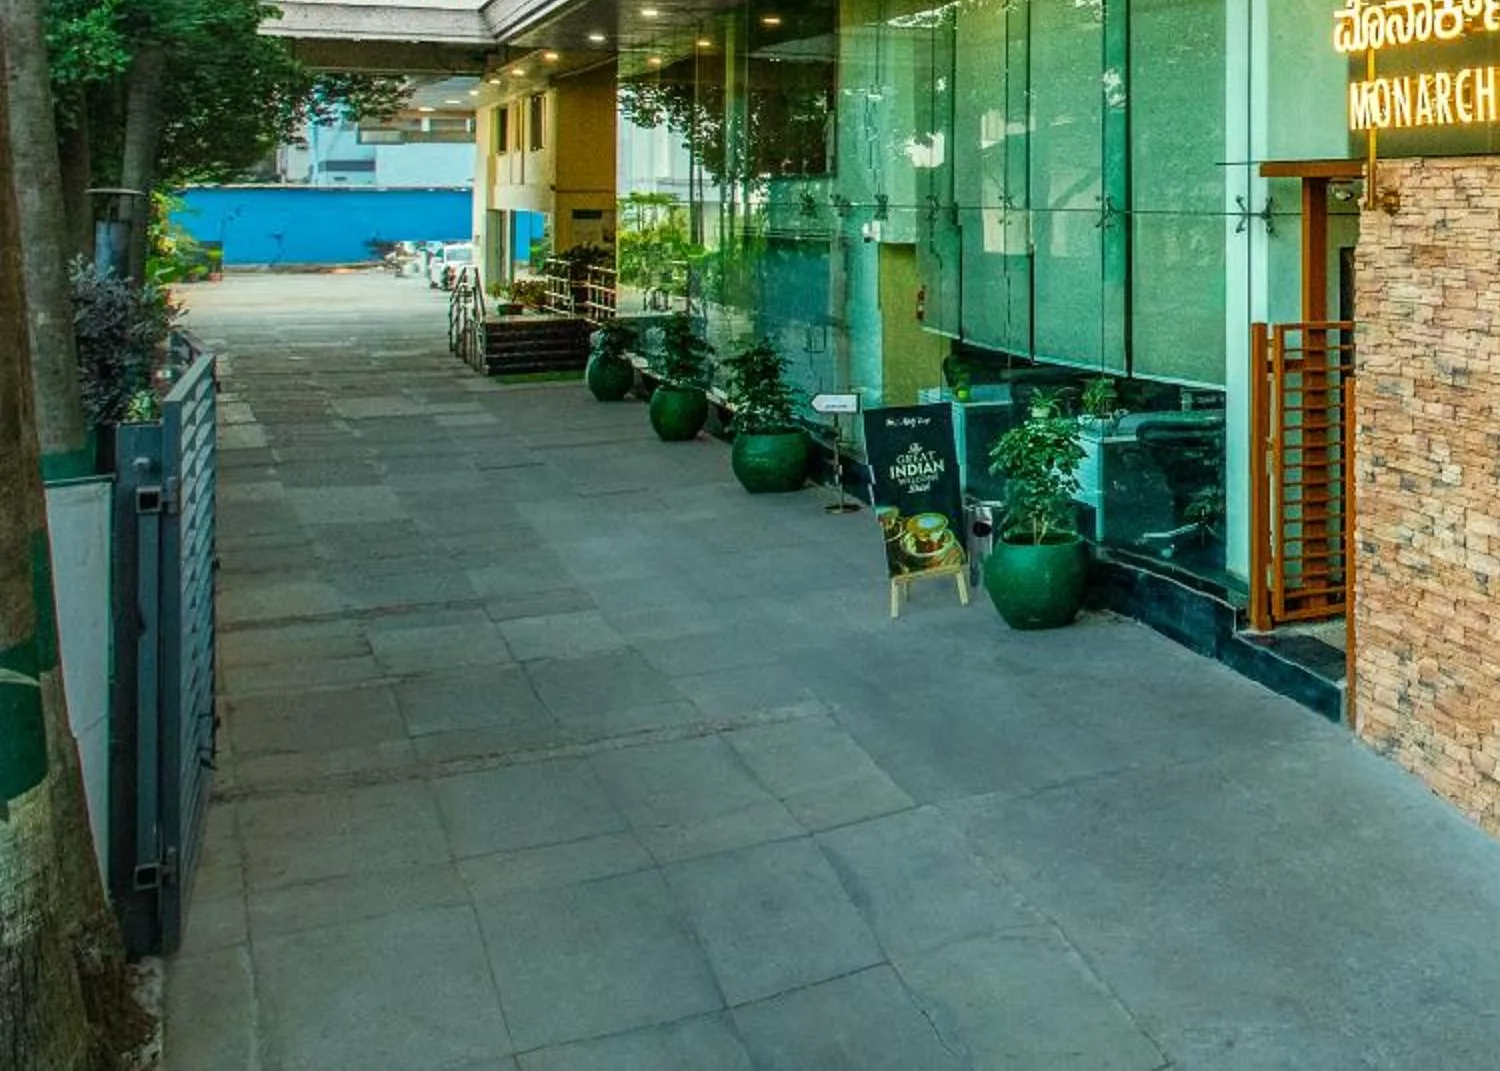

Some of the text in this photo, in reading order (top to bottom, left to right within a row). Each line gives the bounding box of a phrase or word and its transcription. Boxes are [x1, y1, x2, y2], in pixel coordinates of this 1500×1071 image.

[1349, 66, 1497, 130] MONARCH
[895, 450, 936, 465] GREAT
[889, 458, 945, 480] INDIAN
